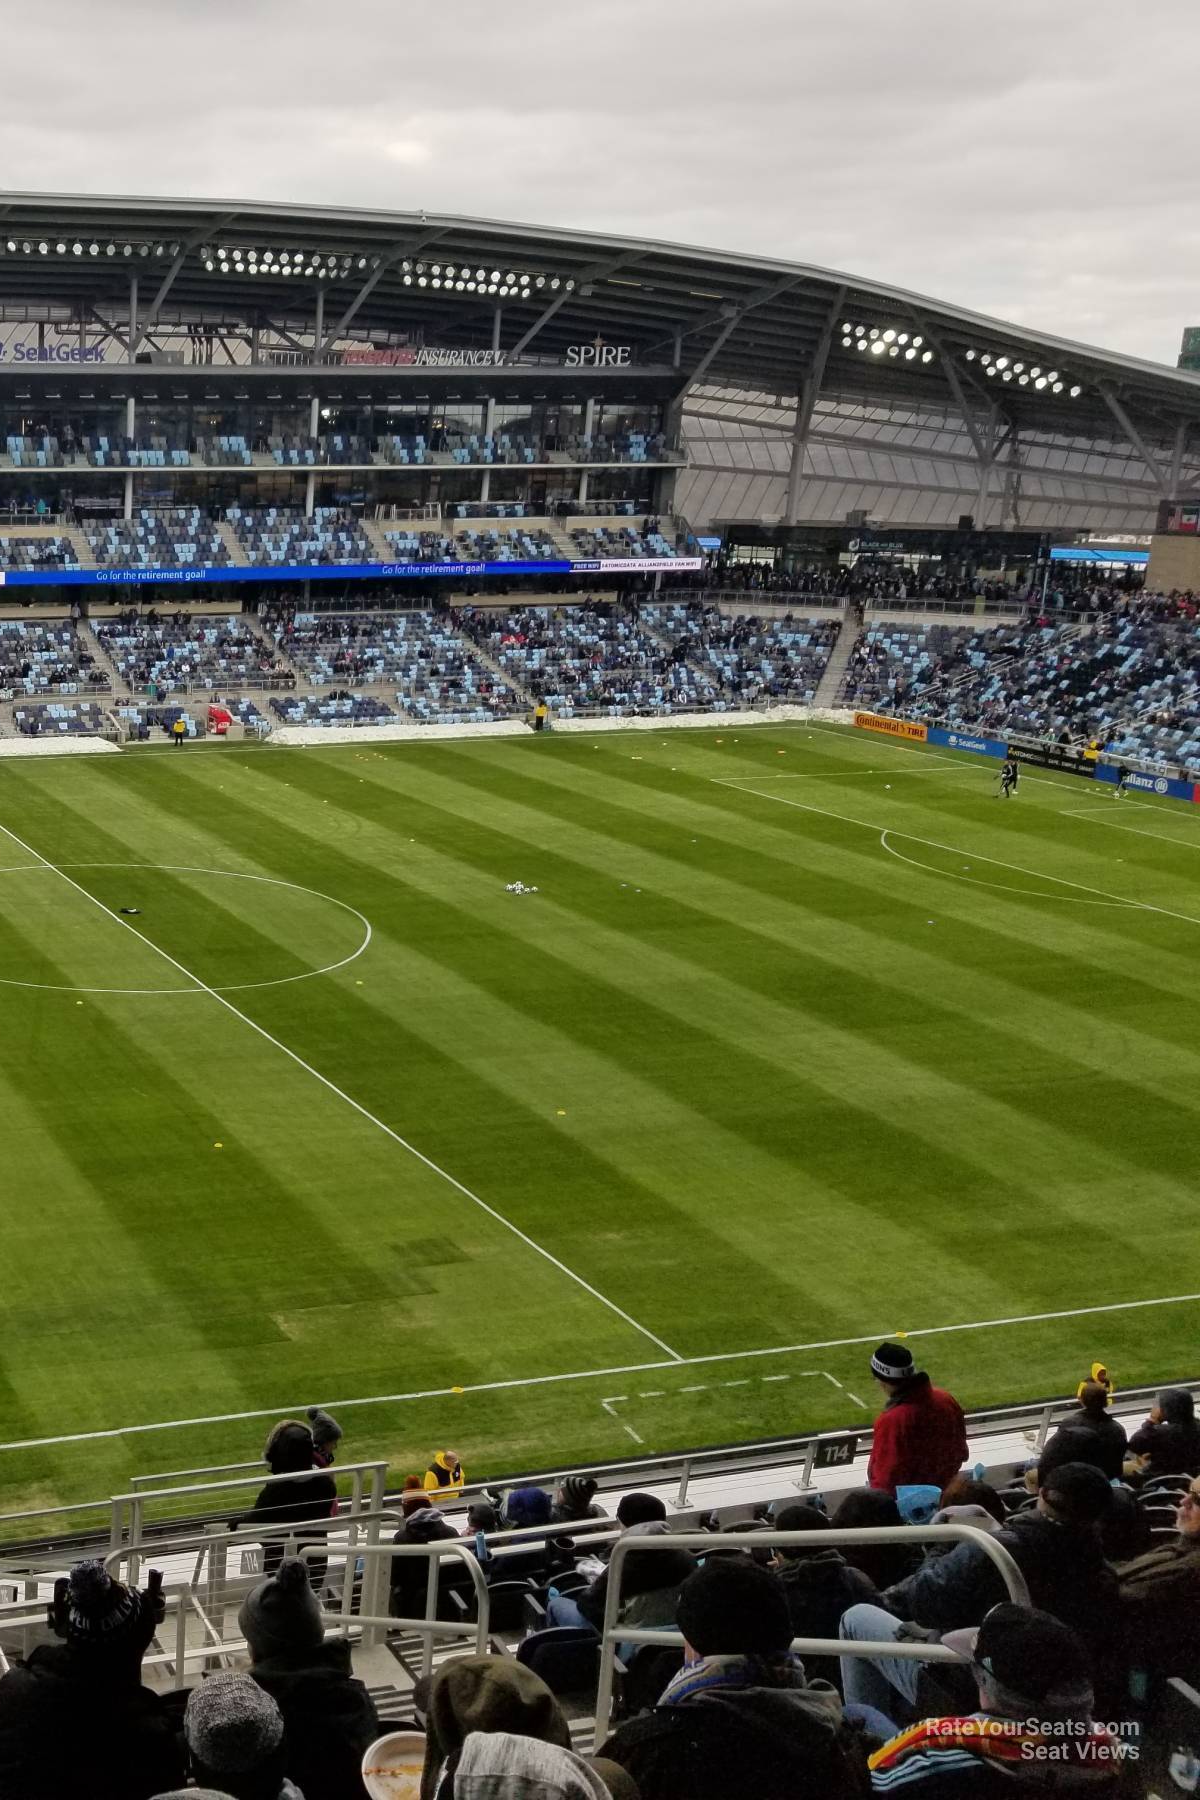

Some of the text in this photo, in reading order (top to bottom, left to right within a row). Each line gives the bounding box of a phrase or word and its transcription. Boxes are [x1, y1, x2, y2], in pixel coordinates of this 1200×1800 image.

[13, 342, 105, 362] SeatGeek
[416, 350, 493, 366] INSURANCE
[566, 346, 631, 366] SPIRE
[96, 571, 108, 580] Go
[110, 571, 121, 580] for
[123, 570, 137, 579] the
[138, 570, 183, 579] retirement
[382, 566, 393, 574] Go
[395, 565, 405, 574] for
[408, 565, 419, 573] the
[421, 564, 464, 573] retirement
[856, 714, 925, 738] Continental TIRE
[824, 1444, 850, 1463] 114
